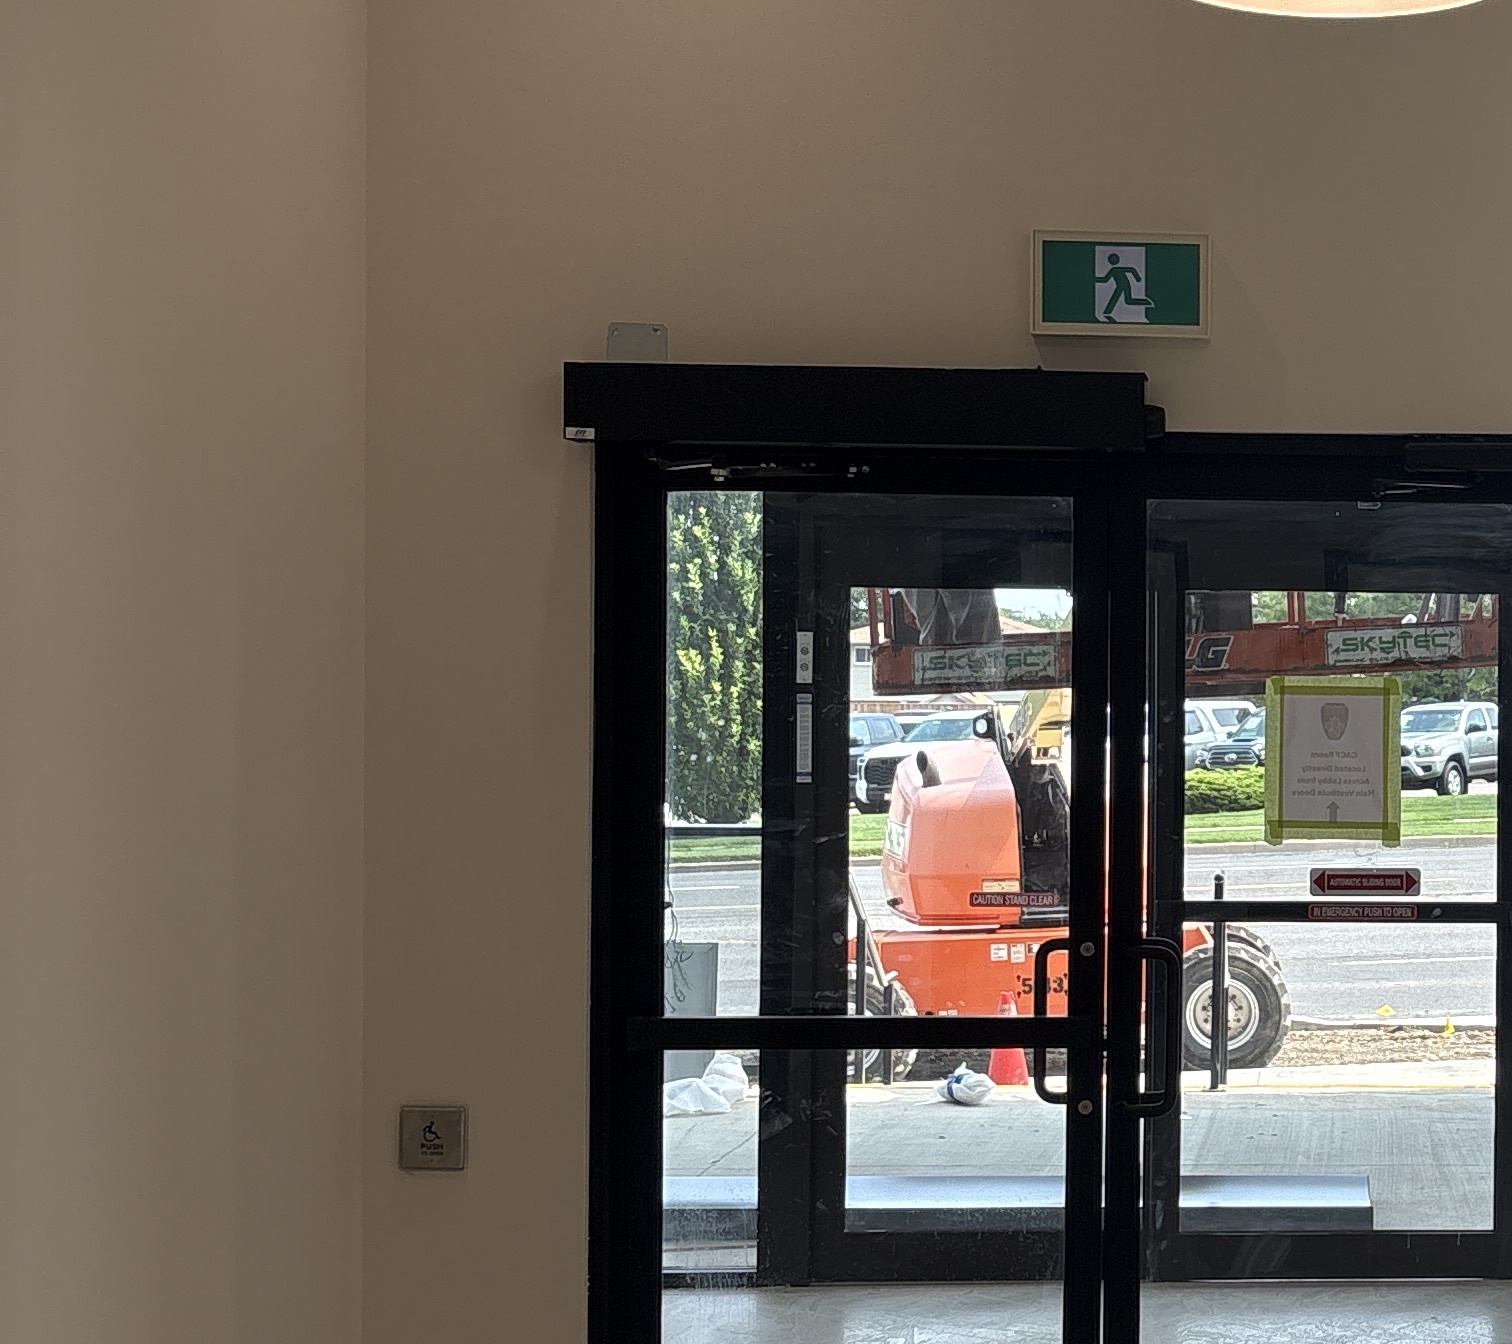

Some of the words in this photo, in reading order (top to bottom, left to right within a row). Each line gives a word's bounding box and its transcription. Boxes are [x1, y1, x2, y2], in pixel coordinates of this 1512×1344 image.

[1331, 630, 1456, 655] SKYTEC
[1329, 877, 1361, 886] AUTOMATIC
[1362, 877, 1384, 886] SLIDING
[1385, 877, 1401, 886] DOOR
[973, 894, 1004, 905] CAUTION
[1004, 894, 1028, 905] STAND
[1029, 894, 1054, 905] CLEAR
[1313, 906, 1321, 916] IN
[1322, 906, 1363, 916] EMERGENCY
[1364, 906, 1382, 916] PUSH
[1383, 906, 1392, 916] TO
[1392, 906, 1412, 916] OPEN
